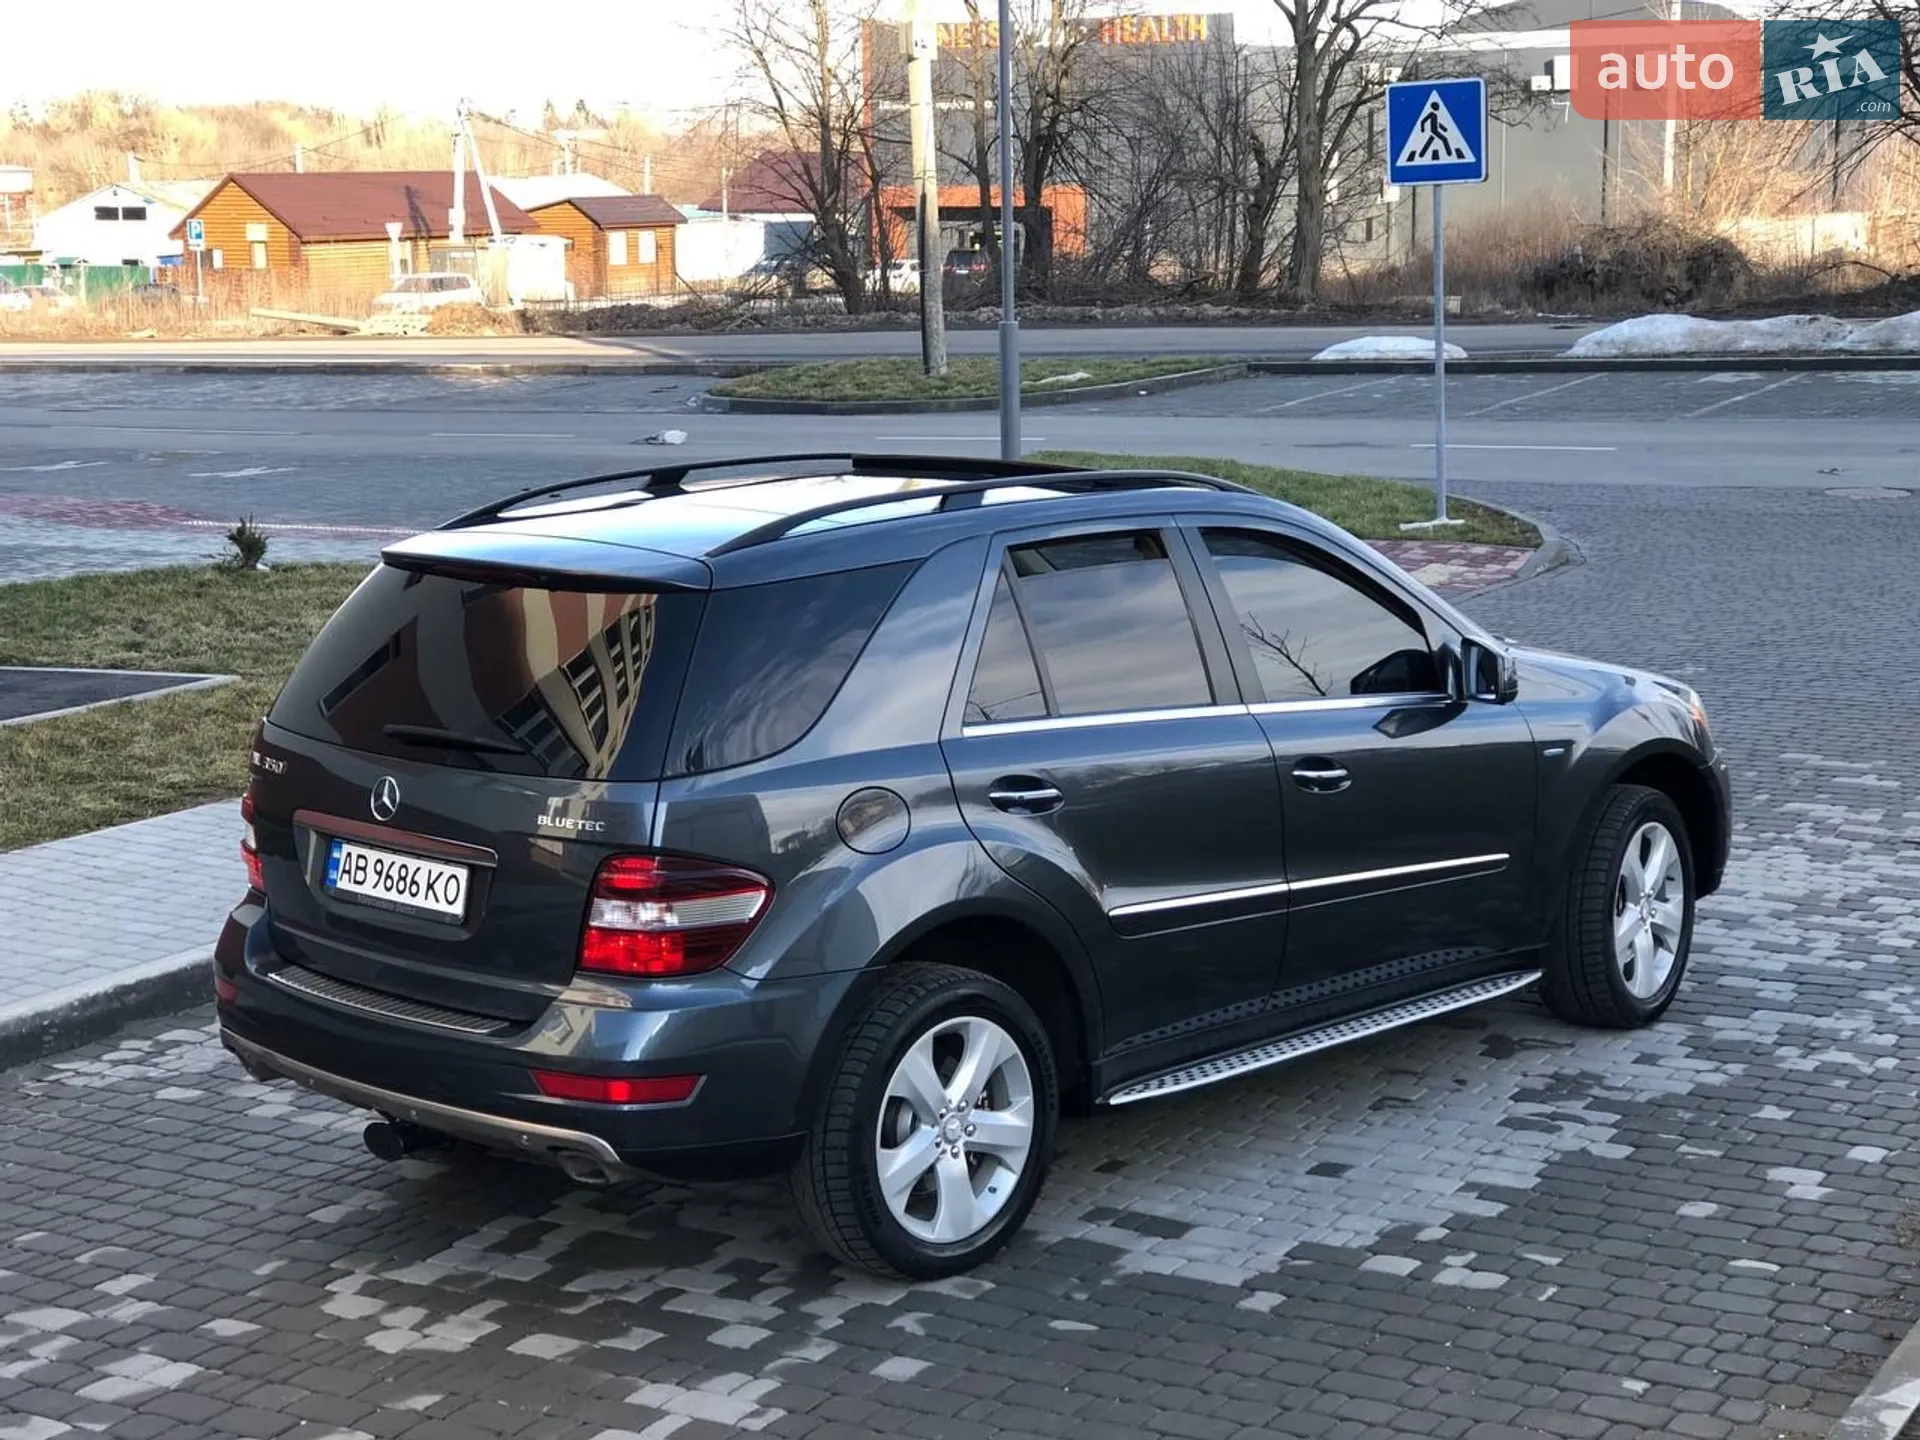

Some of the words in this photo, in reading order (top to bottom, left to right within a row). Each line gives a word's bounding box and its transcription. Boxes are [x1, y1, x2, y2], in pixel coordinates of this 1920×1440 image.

[1101, 14, 1207, 44] HEALTH
[190, 221, 202, 239] P
[537, 814, 606, 832] BLUETEC
